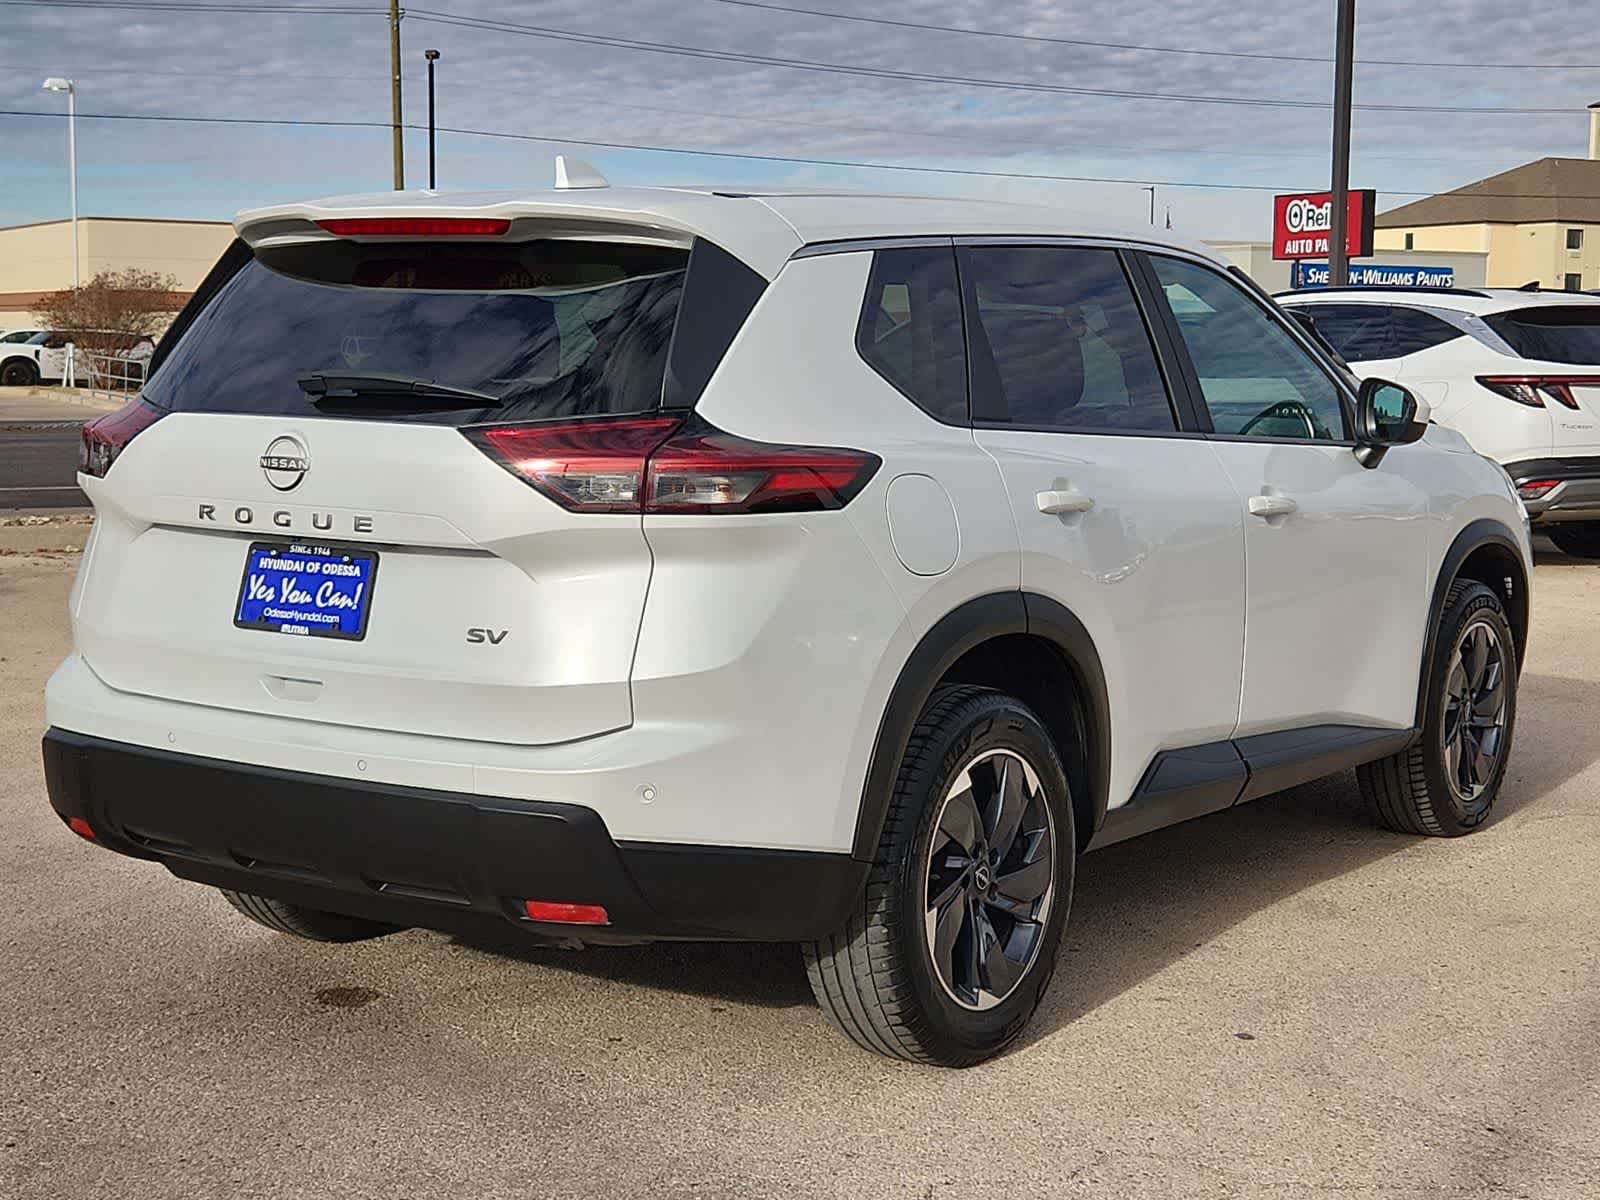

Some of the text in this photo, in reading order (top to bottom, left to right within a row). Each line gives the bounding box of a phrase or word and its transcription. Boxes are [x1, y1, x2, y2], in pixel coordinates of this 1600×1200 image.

[1289, 203, 1331, 229] O'Rei
[1285, 239, 1313, 254] AUTO
[1307, 268, 1414, 286] SHEN-WILLIAMS
[260, 457, 309, 471] NISSAN
[199, 504, 373, 533] ROGUE
[259, 558, 361, 577] HYUNDAI OF ODESSA
[248, 574, 364, 610] Yes You Can!
[466, 628, 509, 644] SV
